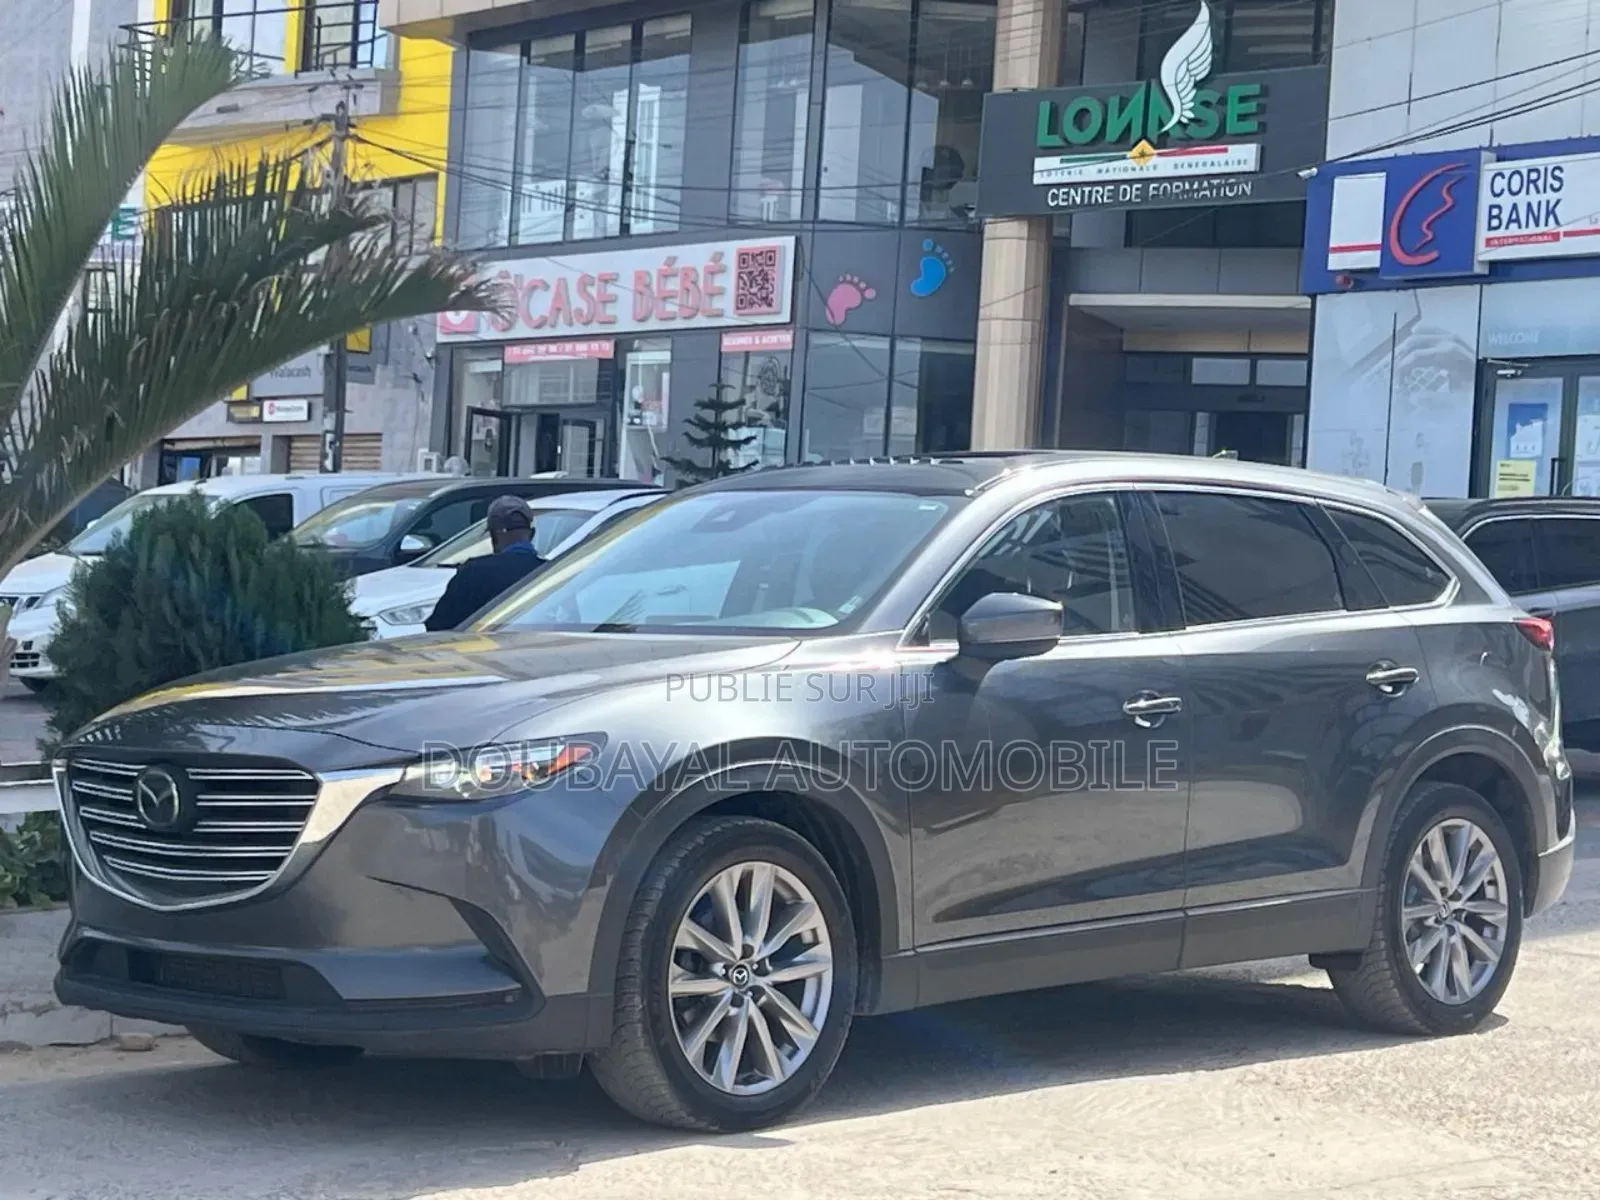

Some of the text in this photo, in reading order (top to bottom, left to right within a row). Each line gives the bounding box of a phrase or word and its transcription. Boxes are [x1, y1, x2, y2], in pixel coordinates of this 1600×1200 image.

[1047, 178, 1253, 207] CENTRE DE FORMATION
[1490, 165, 1564, 198] CORIS
[1487, 198, 1562, 231] BANK
[632, 251, 726, 322] BÉBÉ
